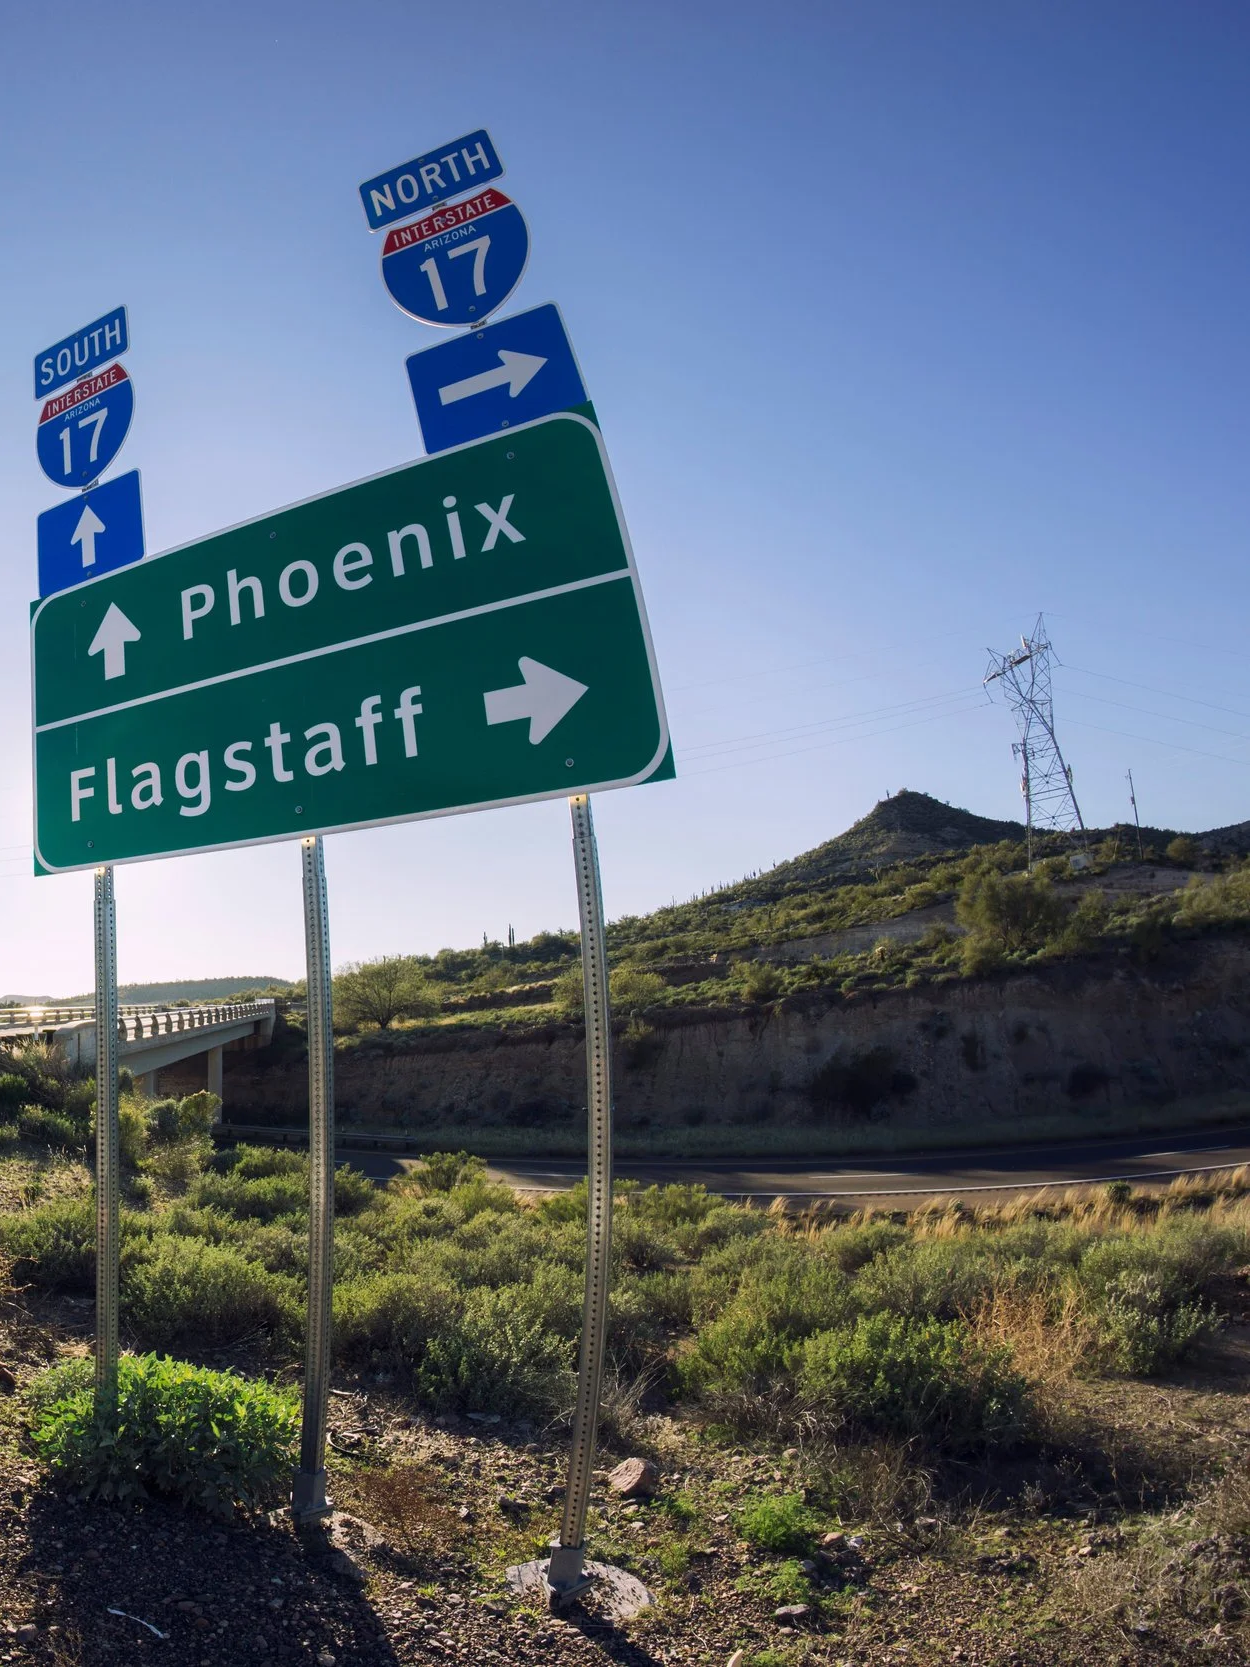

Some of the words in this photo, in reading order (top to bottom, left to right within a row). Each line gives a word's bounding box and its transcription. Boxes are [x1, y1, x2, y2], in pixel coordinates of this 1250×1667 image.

[369, 142, 490, 217] NORTH
[393, 194, 496, 248] INTERSTATE
[424, 224, 476, 252] ARIZONA
[419, 235, 491, 311] 17
[40, 318, 121, 386] SOUTH
[47, 369, 117, 417] INTERSTATE
[64, 398, 100, 422] ARIZONA
[59, 407, 108, 475] 17
[180, 493, 526, 640] Phoenix
[69, 686, 423, 823] Flagstaff
